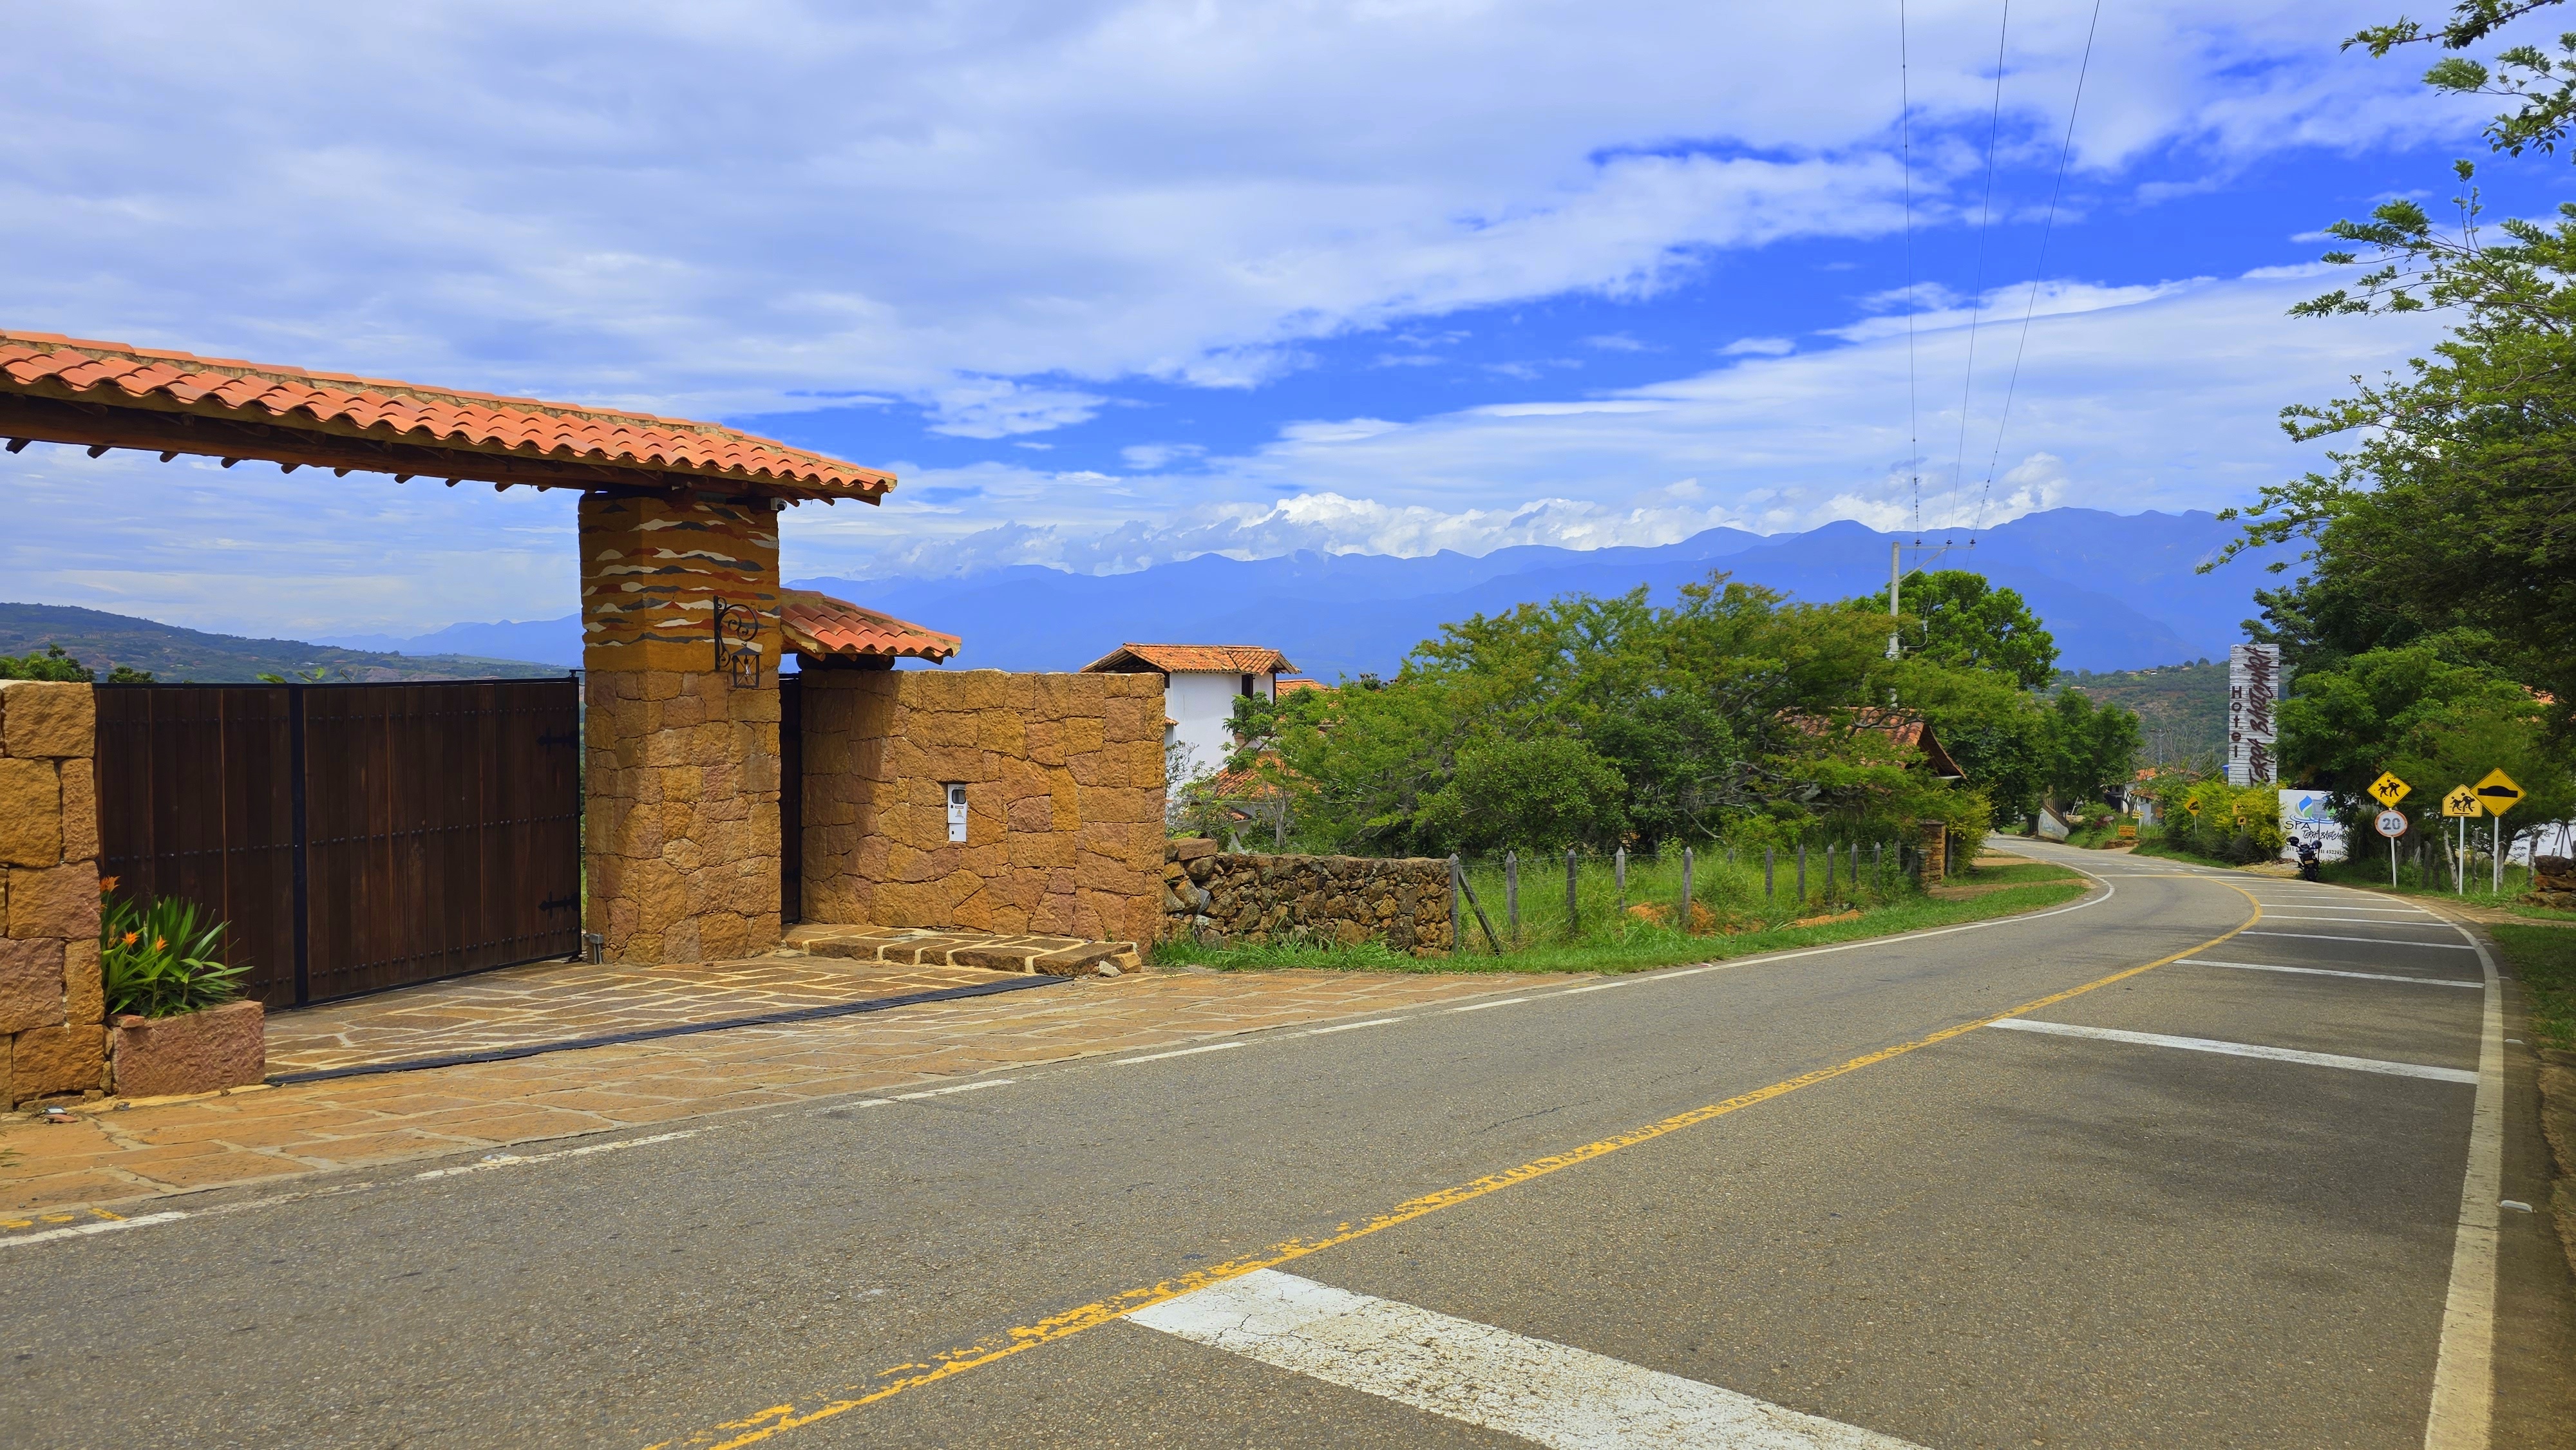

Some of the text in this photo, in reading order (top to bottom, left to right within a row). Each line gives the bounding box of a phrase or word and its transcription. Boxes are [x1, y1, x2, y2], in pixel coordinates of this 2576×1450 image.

[2231, 685, 2242, 758] Hotel
[2243, 646, 2280, 787] TERRA BARICHARA
[2284, 820, 2311, 831] SPA
[2382, 817, 2401, 830] 20
